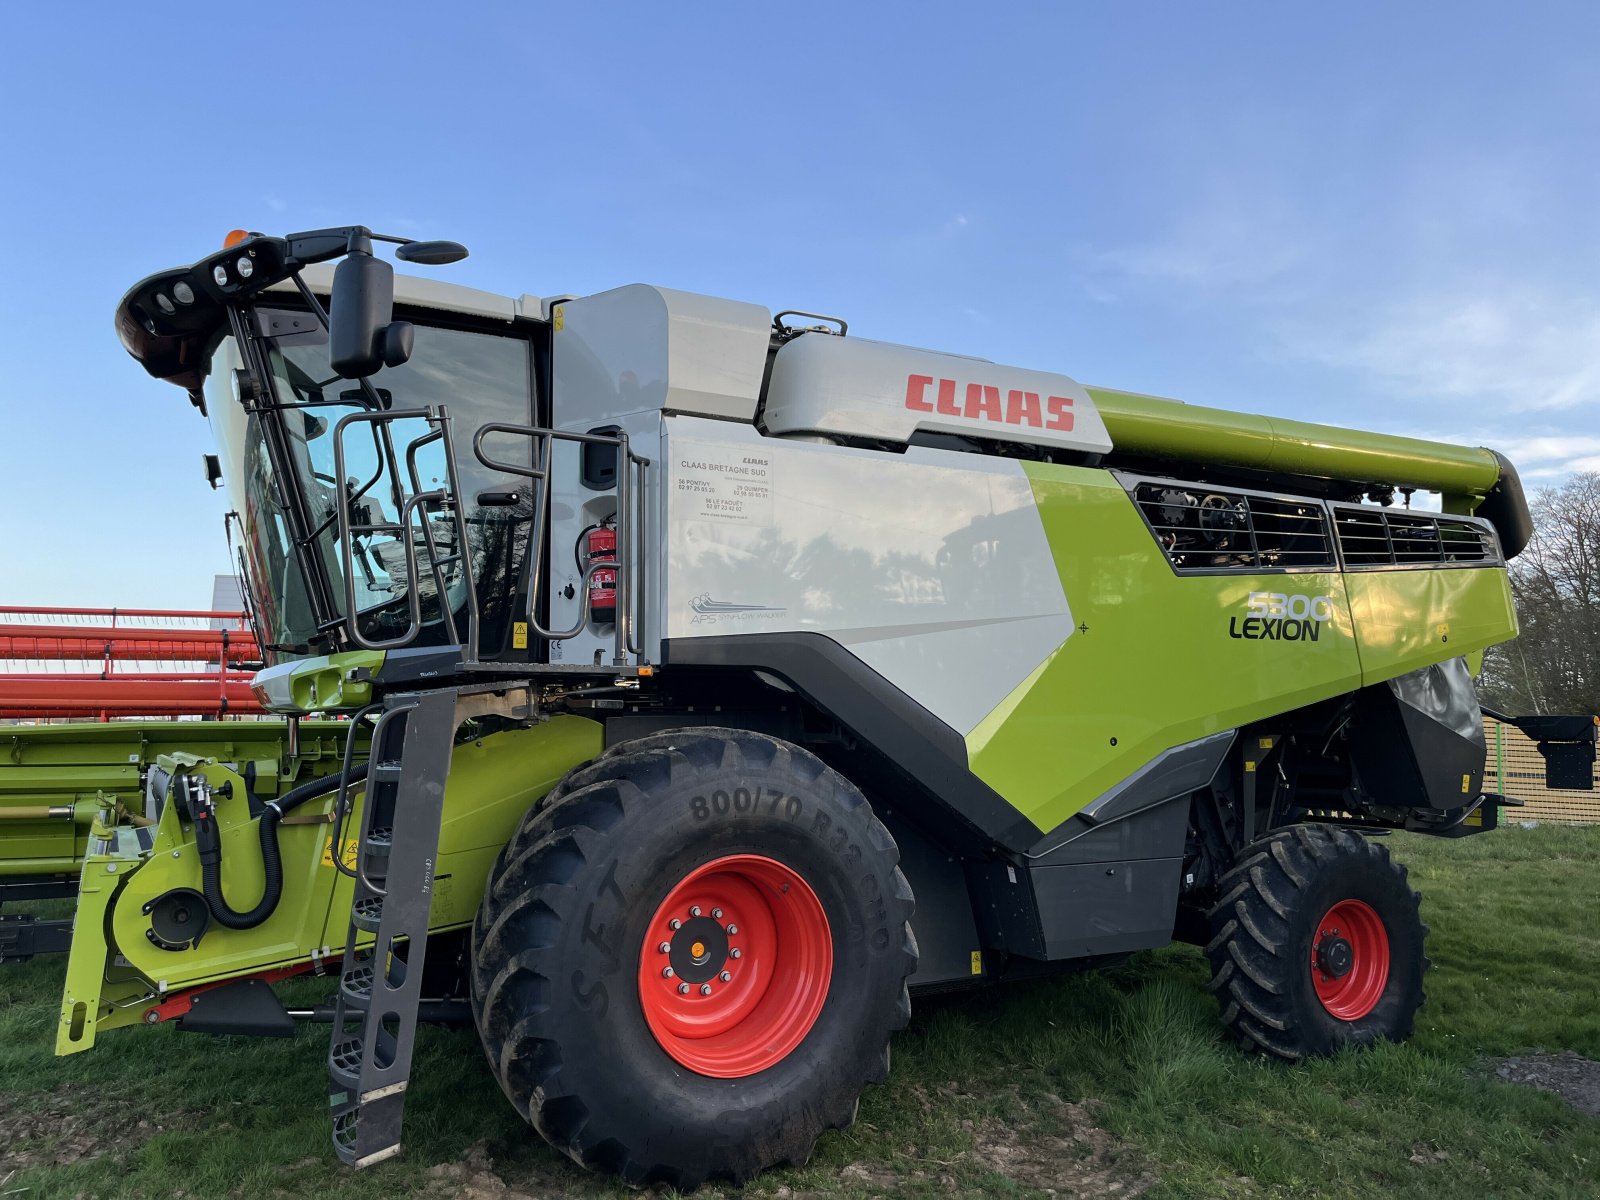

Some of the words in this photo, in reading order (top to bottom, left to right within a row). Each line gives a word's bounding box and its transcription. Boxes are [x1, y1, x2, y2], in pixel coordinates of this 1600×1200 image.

[905, 374, 1075, 432] CLAAS
[681, 460, 707, 470] CLAAS
[708, 463, 749, 475] BRETAGNE
[751, 469, 766, 477] SUD
[742, 457, 769, 466] CLAAS
[690, 614, 718, 625] APS
[1246, 591, 1334, 622] 5300
[1229, 616, 1320, 642] LEXION
[689, 786, 803, 823] 800/70
